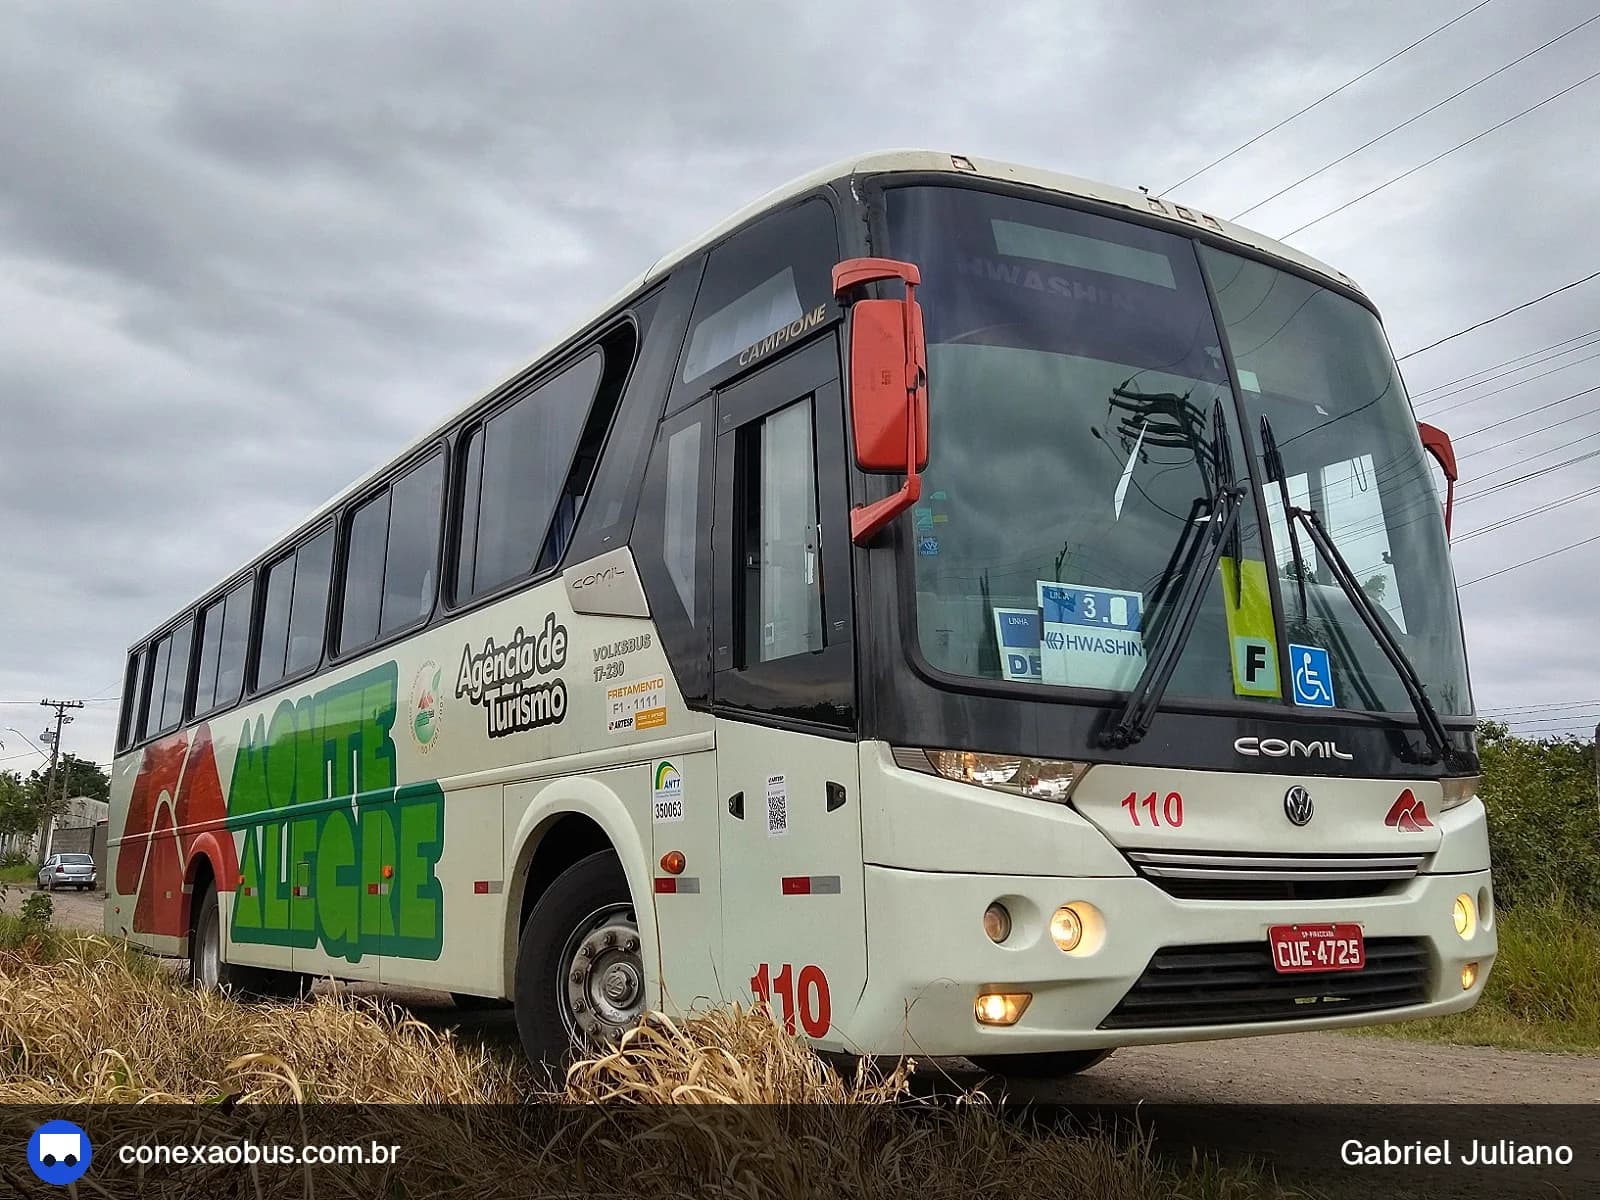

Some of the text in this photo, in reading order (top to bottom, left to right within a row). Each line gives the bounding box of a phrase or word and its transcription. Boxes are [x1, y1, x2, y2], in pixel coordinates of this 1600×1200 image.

[739, 303, 826, 366] CAMPIONE
[572, 567, 625, 589] COMIL
[1009, 617, 1029, 626] LINHA
[593, 633, 651, 661] VOLKSBUS
[1066, 634, 1142, 657] HWASHIN
[455, 612, 568, 705] Agência de
[1246, 645, 1266, 682] F
[593, 660, 625, 682] 17-230
[607, 678, 664, 700] FRETAMENTO
[484, 677, 568, 738] Turismo
[613, 701, 624, 715] F1
[633, 694, 657, 710] 1111
[613, 717, 634, 730] ARTESP
[227, 665, 398, 818] MONTE
[1234, 737, 1353, 760] COMIL
[664, 778, 681, 790] ANTT
[655, 800, 682, 819] 350063
[1121, 790, 1185, 828] 110
[231, 800, 441, 954] ALEGRE
[750, 963, 832, 1039] 110
